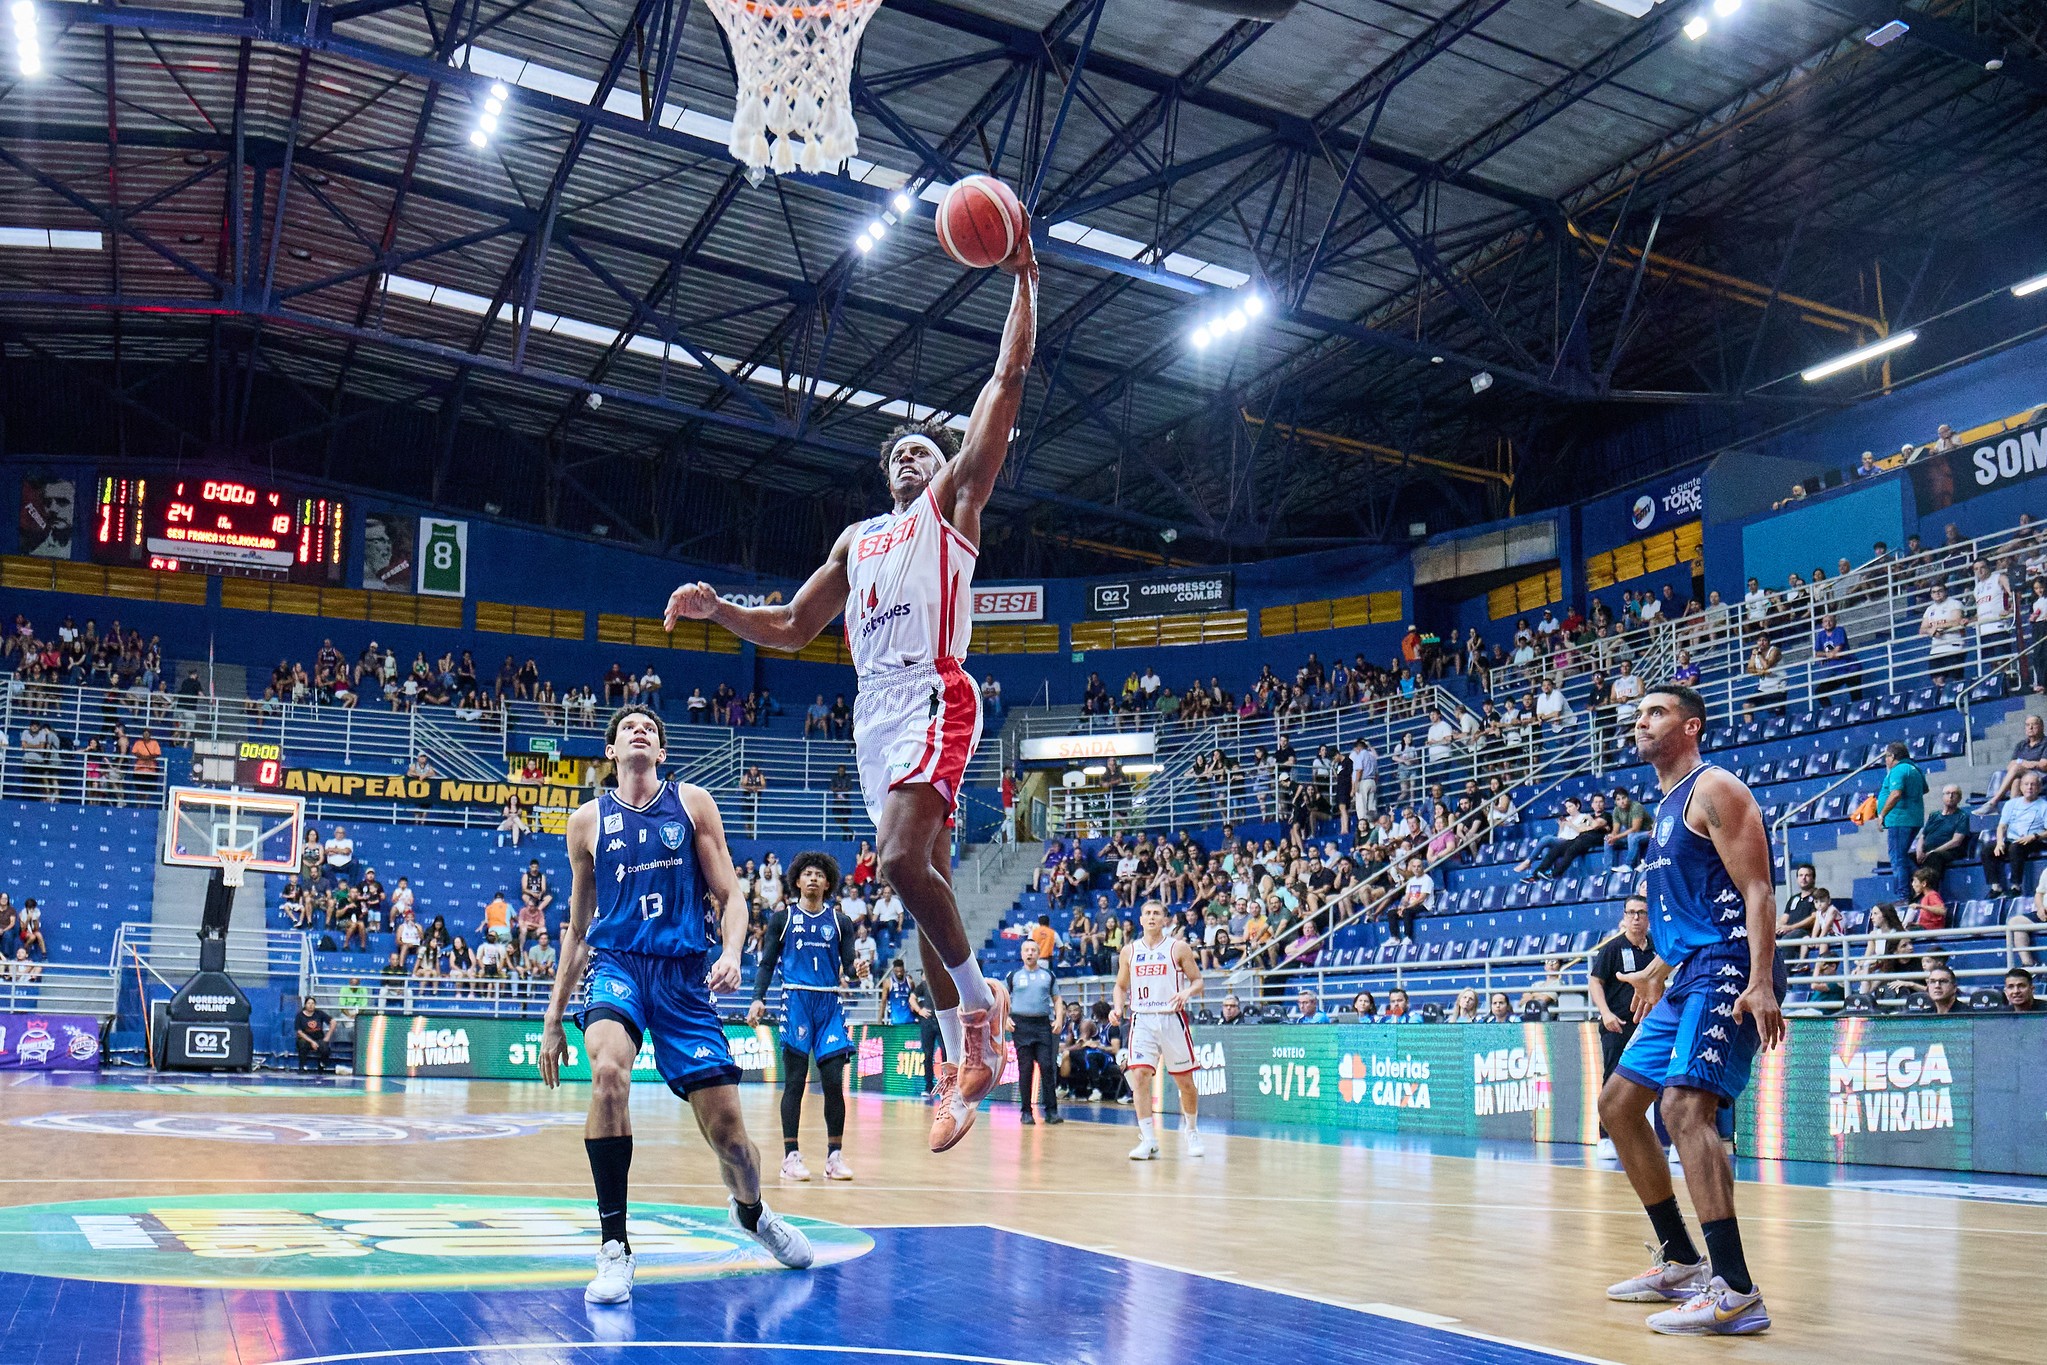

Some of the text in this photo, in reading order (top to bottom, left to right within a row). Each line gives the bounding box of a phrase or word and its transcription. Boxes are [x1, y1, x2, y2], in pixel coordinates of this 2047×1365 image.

[1677, 477, 1702, 492] gente
[269, 493, 279, 507] 4
[168, 502, 194, 522] 24
[272, 515, 290, 533] 18
[167, 527, 186, 540] SESI
[187, 530, 218, 544] FRANCA
[434, 541, 452, 570] 8
[1101, 590, 1120, 602] Q2
[1141, 580, 1223, 596] Q2INGRESSOS
[1174, 589, 1222, 603] .COM.BR
[979, 593, 1031, 613] SESI
[240, 742, 279, 760] 00:00
[260, 760, 278, 784] 0
[280, 770, 581, 808] AMPEÃO MUNDIAL
[639, 892, 663, 920] 13
[813, 956, 818, 972] 1
[1137, 965, 1164, 976] SESI
[1138, 986, 1149, 1000] 10
[194, 1003, 227, 1012] ONLINE
[195, 1032, 218, 1047] Q2
[407, 1029, 470, 1049] MEGA
[407, 1046, 470, 1066] DA VIRADA
[1194, 1042, 1226, 1069] EGA
[1272, 1046, 1305, 1059] SORTEIO
[1371, 1054, 1430, 1079] loterias
[1474, 1044, 1549, 1084] MEGA
[1829, 1043, 1953, 1093] MEGA
[1258, 1062, 1320, 1101] 31/12
[1372, 1080, 1431, 1109] CAIXA
[1474, 1076, 1549, 1115] DA VIRADA
[1829, 1087, 1953, 1135] DA VIRADA
